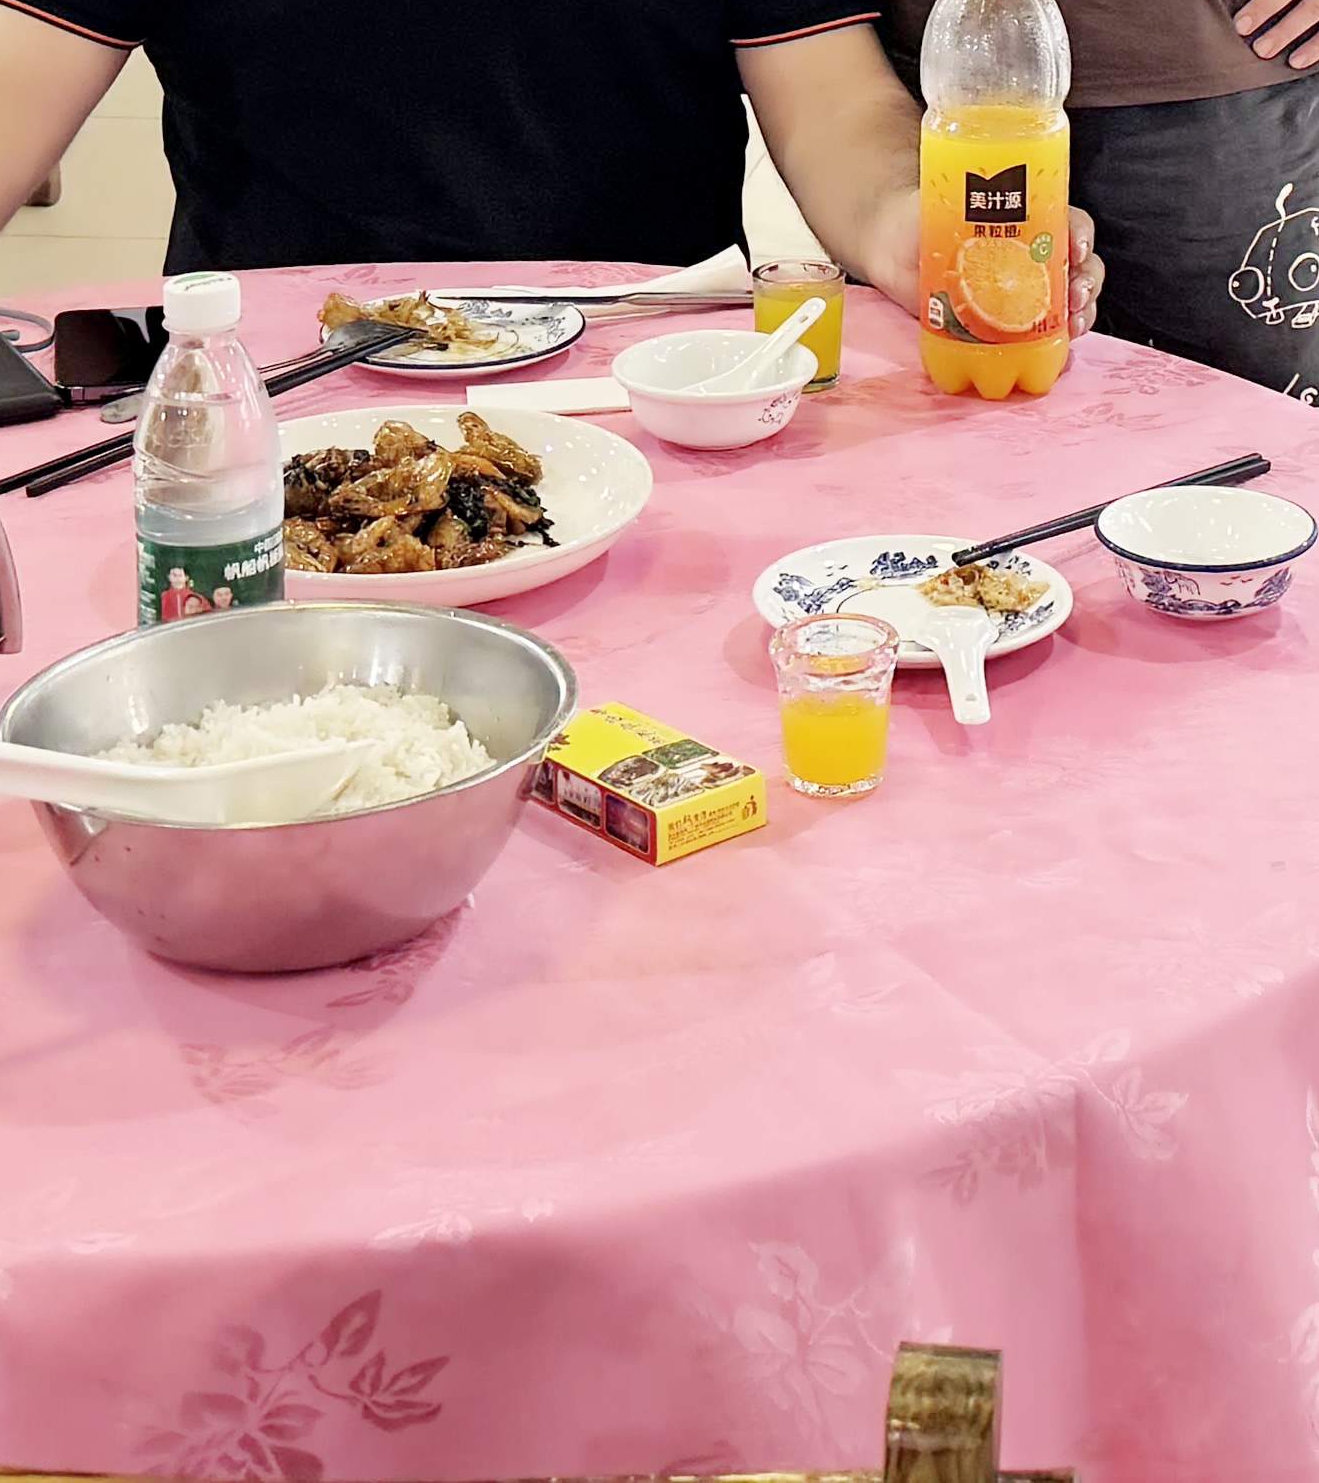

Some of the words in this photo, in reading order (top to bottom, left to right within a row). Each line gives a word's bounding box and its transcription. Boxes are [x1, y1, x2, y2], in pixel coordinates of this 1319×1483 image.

[969, 191, 1022, 210] 美汁源
[974, 224, 1021, 238] 果粒橙
